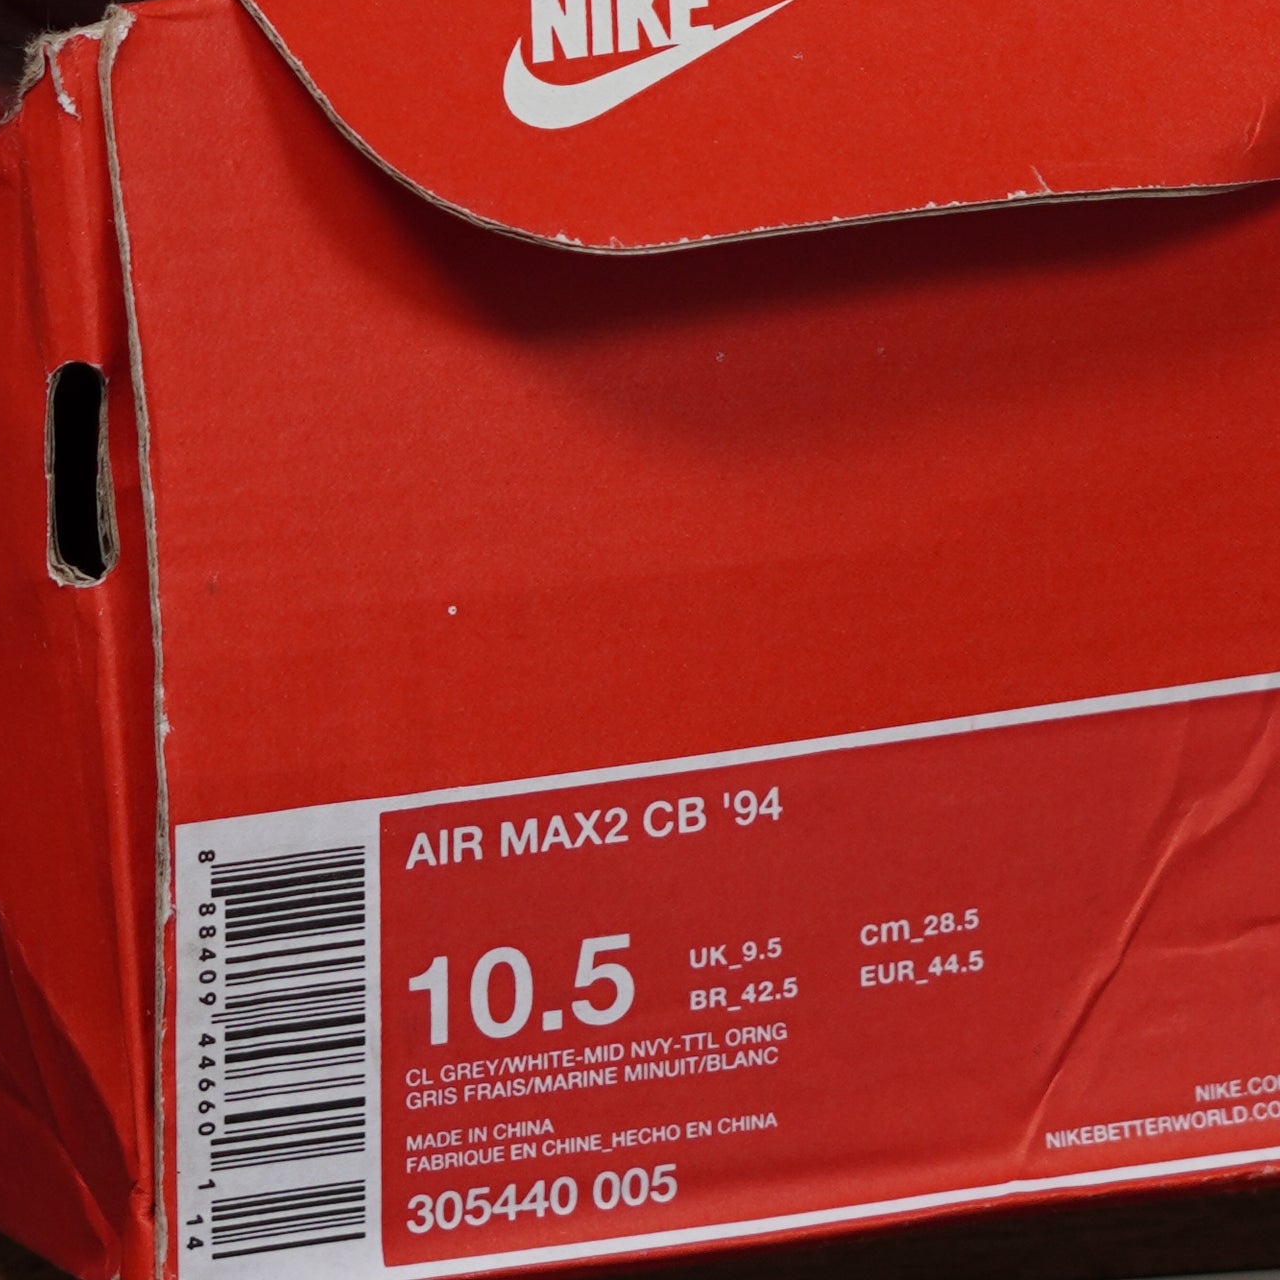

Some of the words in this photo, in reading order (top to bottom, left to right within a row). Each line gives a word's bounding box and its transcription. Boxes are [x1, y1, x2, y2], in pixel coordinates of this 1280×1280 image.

[405, 825, 484, 871] AIR
[500, 807, 629, 858] MAX2
[642, 796, 708, 838] CB
[723, 786, 784, 827] '94
[197, 901, 218, 1007] 88409
[689, 937, 783, 970] UK_9.5
[859, 950, 985, 987] EUR_44.5
[408, 933, 636, 1046] 10.5
[689, 977, 799, 1012] BR_42.5
[197, 1031, 217, 1137] 44660
[405, 1067, 435, 1087] CL
[440, 1044, 625, 1084] GREY/WHITE-MID
[630, 1031, 720, 1059] NVY-TTL
[725, 1022, 789, 1047] ORNG
[405, 1089, 458, 1110] GRIS
[464, 1066, 618, 1102] FRAIS/MARINE
[624, 1046, 780, 1082] MINUIT/BLANC
[406, 1129, 462, 1151] MADE
[468, 1126, 488, 1143] IN
[493, 1118, 555, 1139] CHINA
[406, 1148, 504, 1174] FABRIQUE
[510, 1143, 537, 1161] EN
[542, 1124, 682, 1158] CHINE_HECHO
[686, 1120, 712, 1139] EN
[717, 1112, 779, 1135] CHINA
[406, 1176, 579, 1234] 305440
[592, 1163, 678, 1210] 005
